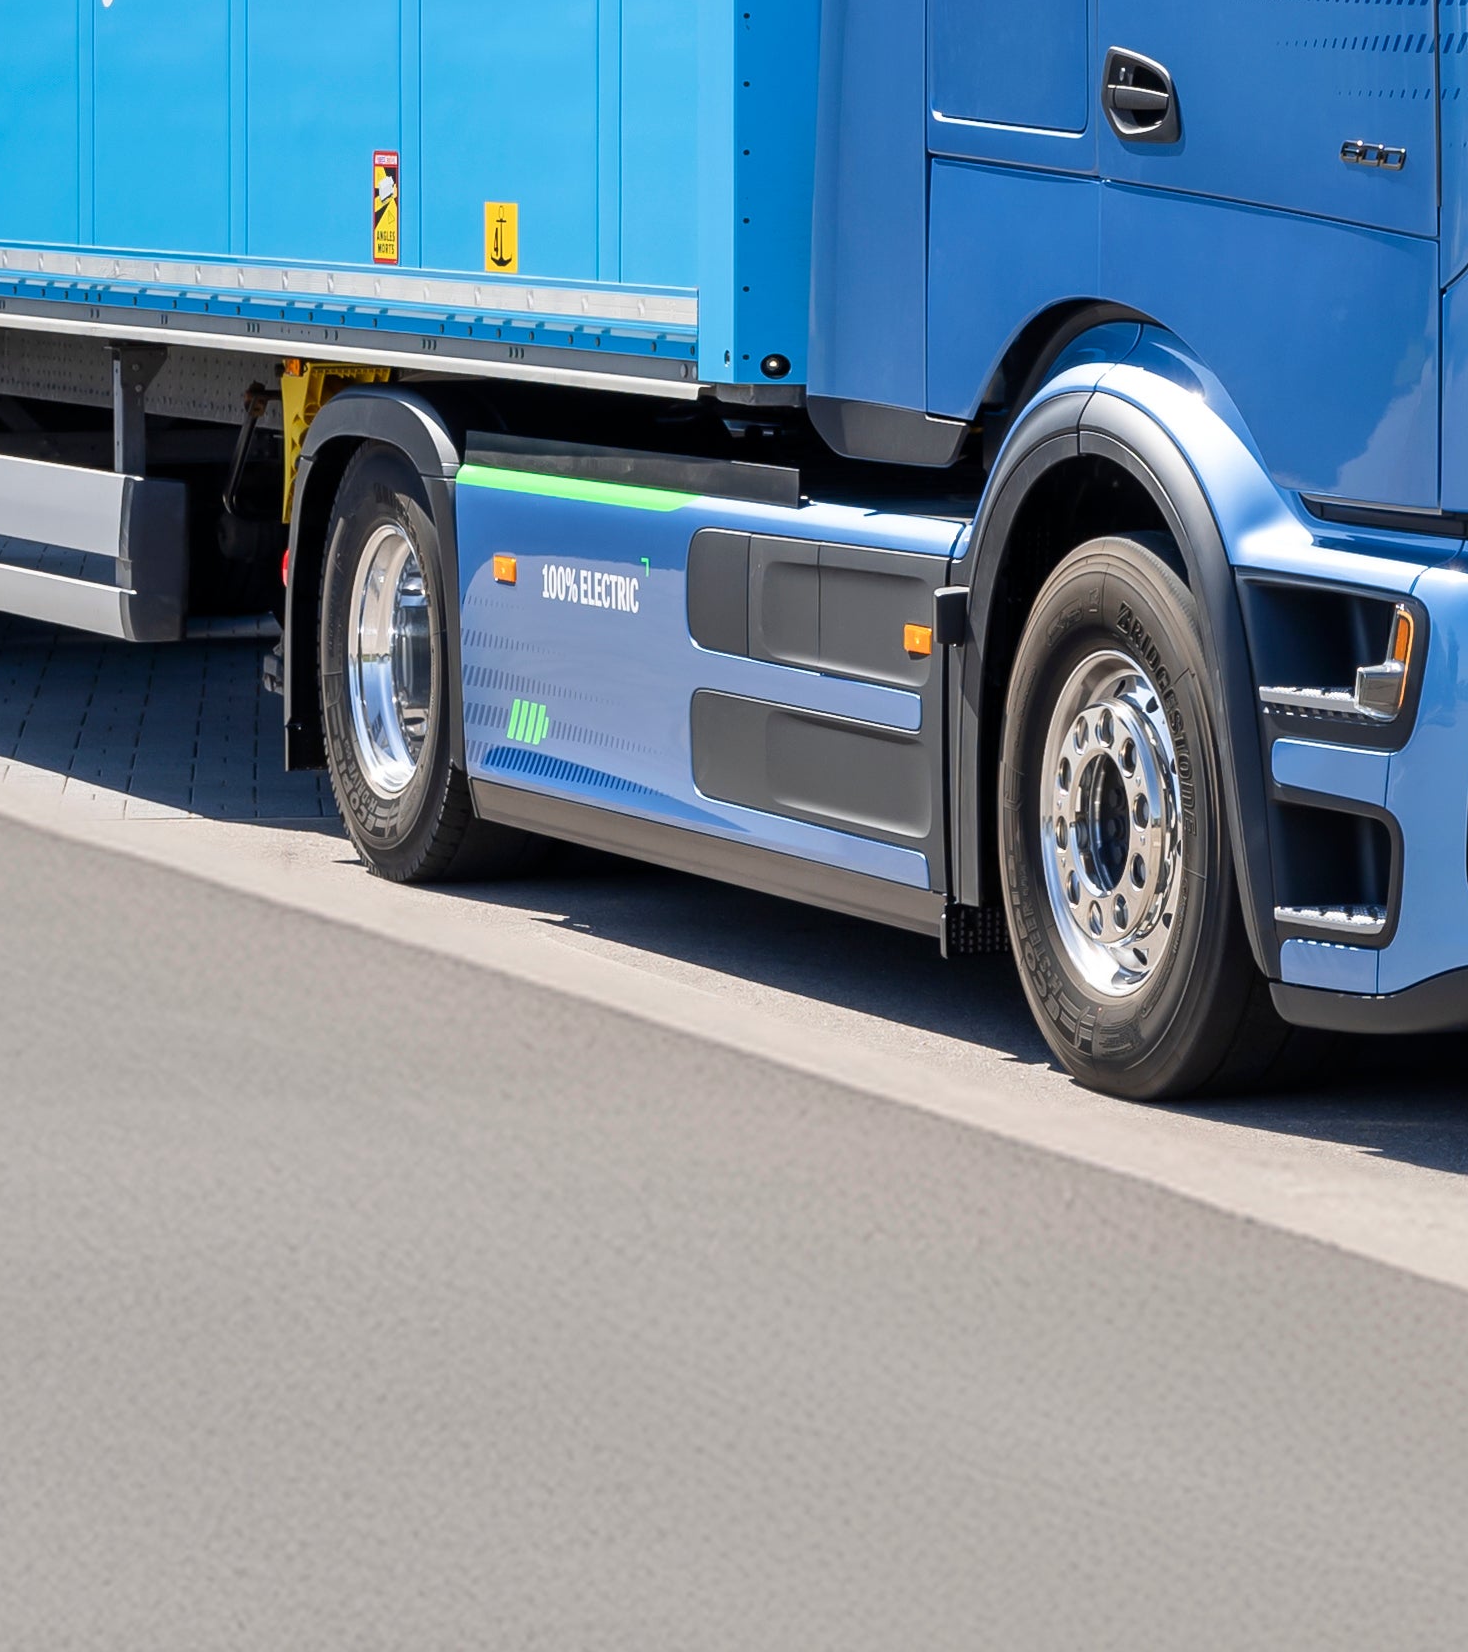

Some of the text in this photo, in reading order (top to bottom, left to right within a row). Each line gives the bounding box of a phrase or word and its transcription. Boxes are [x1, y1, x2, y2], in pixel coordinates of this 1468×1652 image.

[376, 230, 396, 242] ANGLES
[377, 243, 395, 255] MORTS
[542, 563, 639, 614] 100% ELECTRIC
[1116, 600, 1197, 837] BRIDGESTONE
